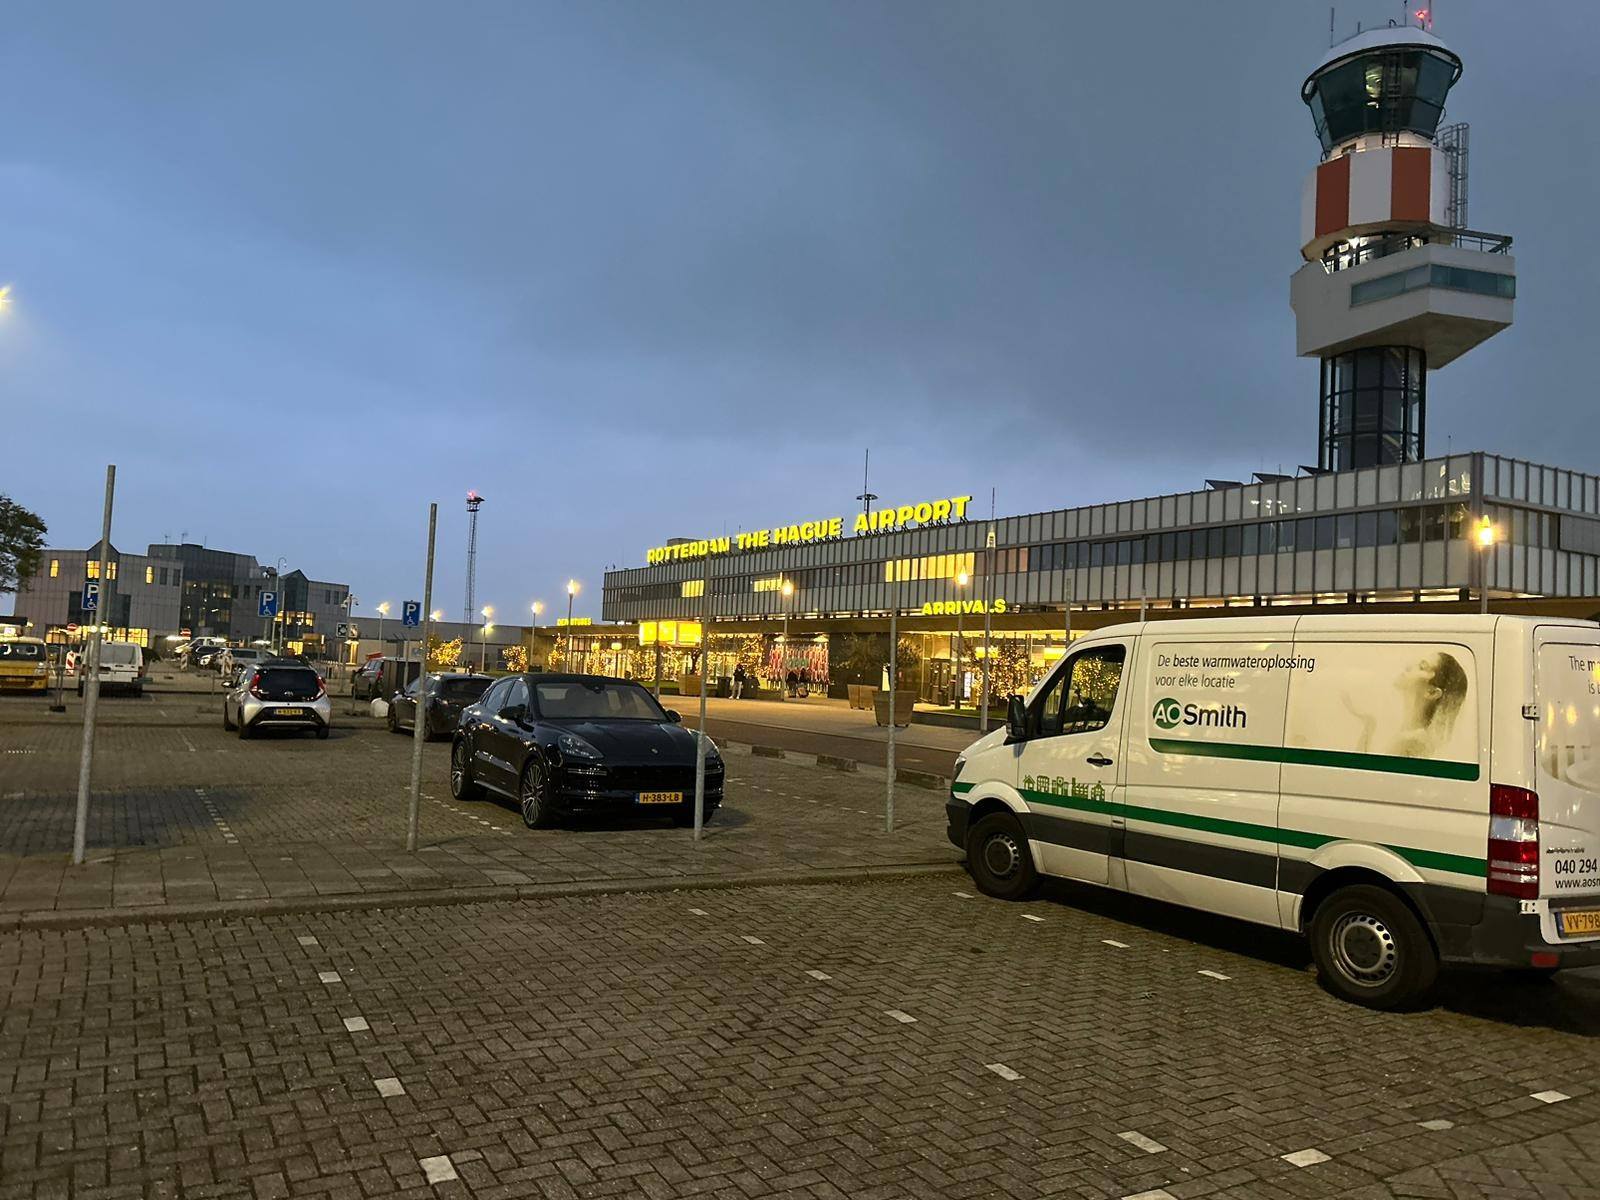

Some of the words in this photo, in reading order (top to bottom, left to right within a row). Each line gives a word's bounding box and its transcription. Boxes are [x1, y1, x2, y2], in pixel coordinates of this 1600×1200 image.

[647, 536, 731, 562] ROTTERDAM
[736, 529, 771, 549] THE
[774, 517, 844, 544] HAGUE
[854, 495, 972, 532] AIRPORT
[263, 592, 274, 606] P
[406, 603, 417, 616] P
[1157, 654, 1171, 667] De
[1173, 654, 1200, 668] beste
[1201, 653, 1316, 673] warmwateroplossing
[1568, 655, 1585, 671] The
[1587, 659, 1600, 671] m
[1155, 675, 1177, 687] voor
[1178, 673, 1199, 688] elke
[1200, 674, 1236, 688] locatie
[1588, 679, 1596, 695] is
[1554, 859, 1577, 875] 040
[1578, 858, 1598, 874] 294
